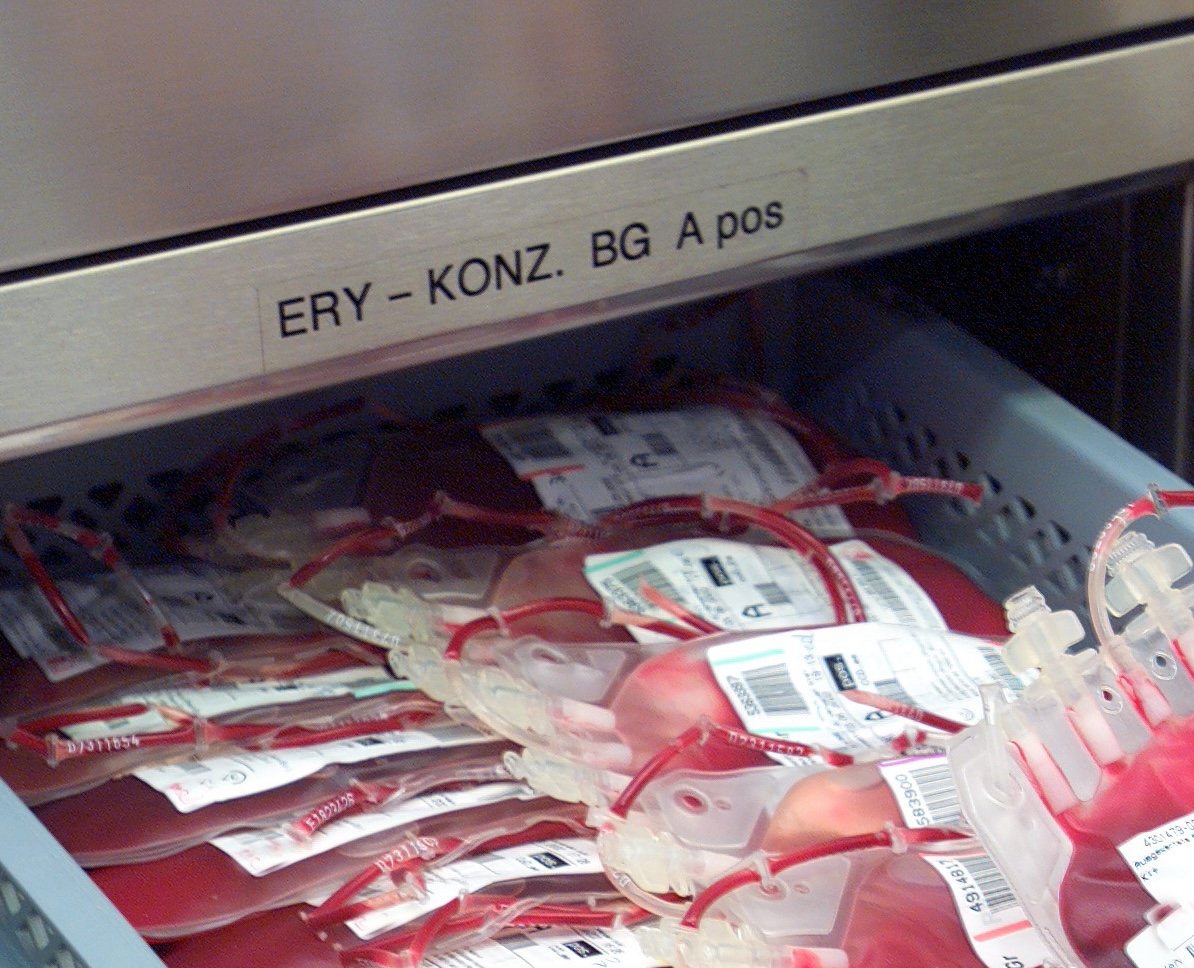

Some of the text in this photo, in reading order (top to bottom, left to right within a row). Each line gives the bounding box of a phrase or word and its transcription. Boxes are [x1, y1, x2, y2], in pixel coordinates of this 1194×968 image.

[277, 282, 373, 338] ERY
[428, 243, 564, 305] KONZ.
[591, 222, 650, 268] BG
[676, 212, 705, 249] A
[716, 201, 784, 248] pos
[737, 603, 771, 619] A
[938, 859, 983, 914] 4914817
